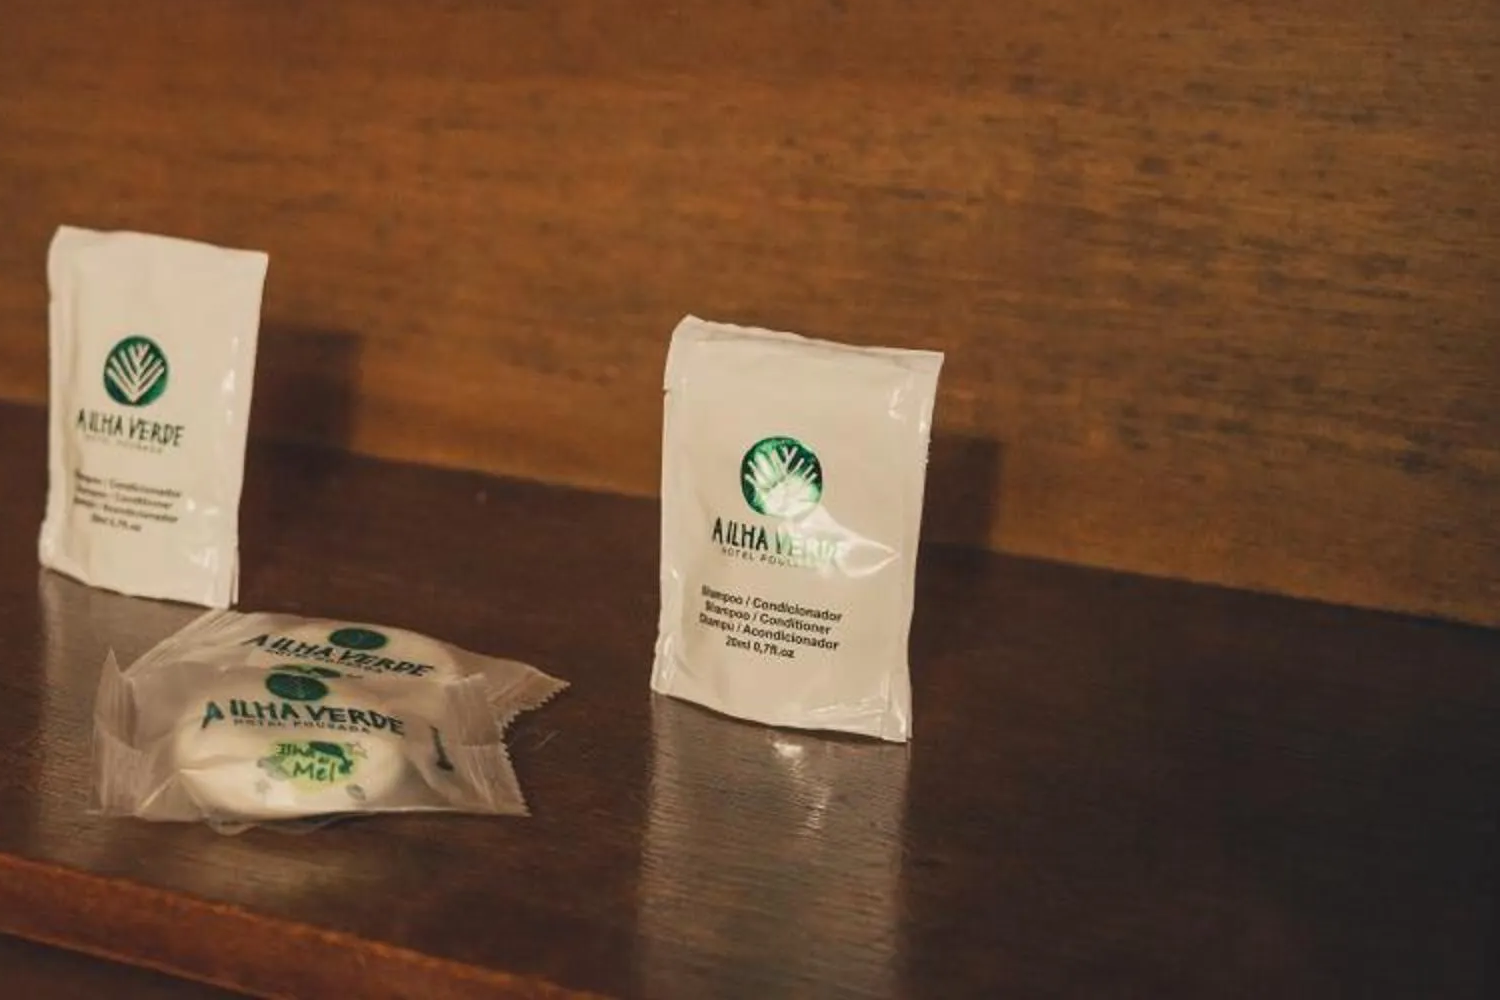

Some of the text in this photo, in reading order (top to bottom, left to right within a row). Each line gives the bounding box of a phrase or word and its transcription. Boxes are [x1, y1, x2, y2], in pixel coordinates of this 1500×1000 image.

[76, 408, 87, 433] A
[89, 409, 124, 437] ILHA
[129, 415, 186, 448] VERDE
[711, 516, 724, 545] A
[725, 520, 769, 551] ILHA
[753, 597, 842, 623] Condicionador
[759, 613, 832, 635] Conditioner
[743, 624, 840, 651] Acondicionador
[241, 634, 270, 647] A
[270, 636, 334, 659] ILHA
[340, 649, 435, 678] VERDE
[201, 699, 406, 735] A ILHA VERDE
[293, 760, 336, 783] Mel
